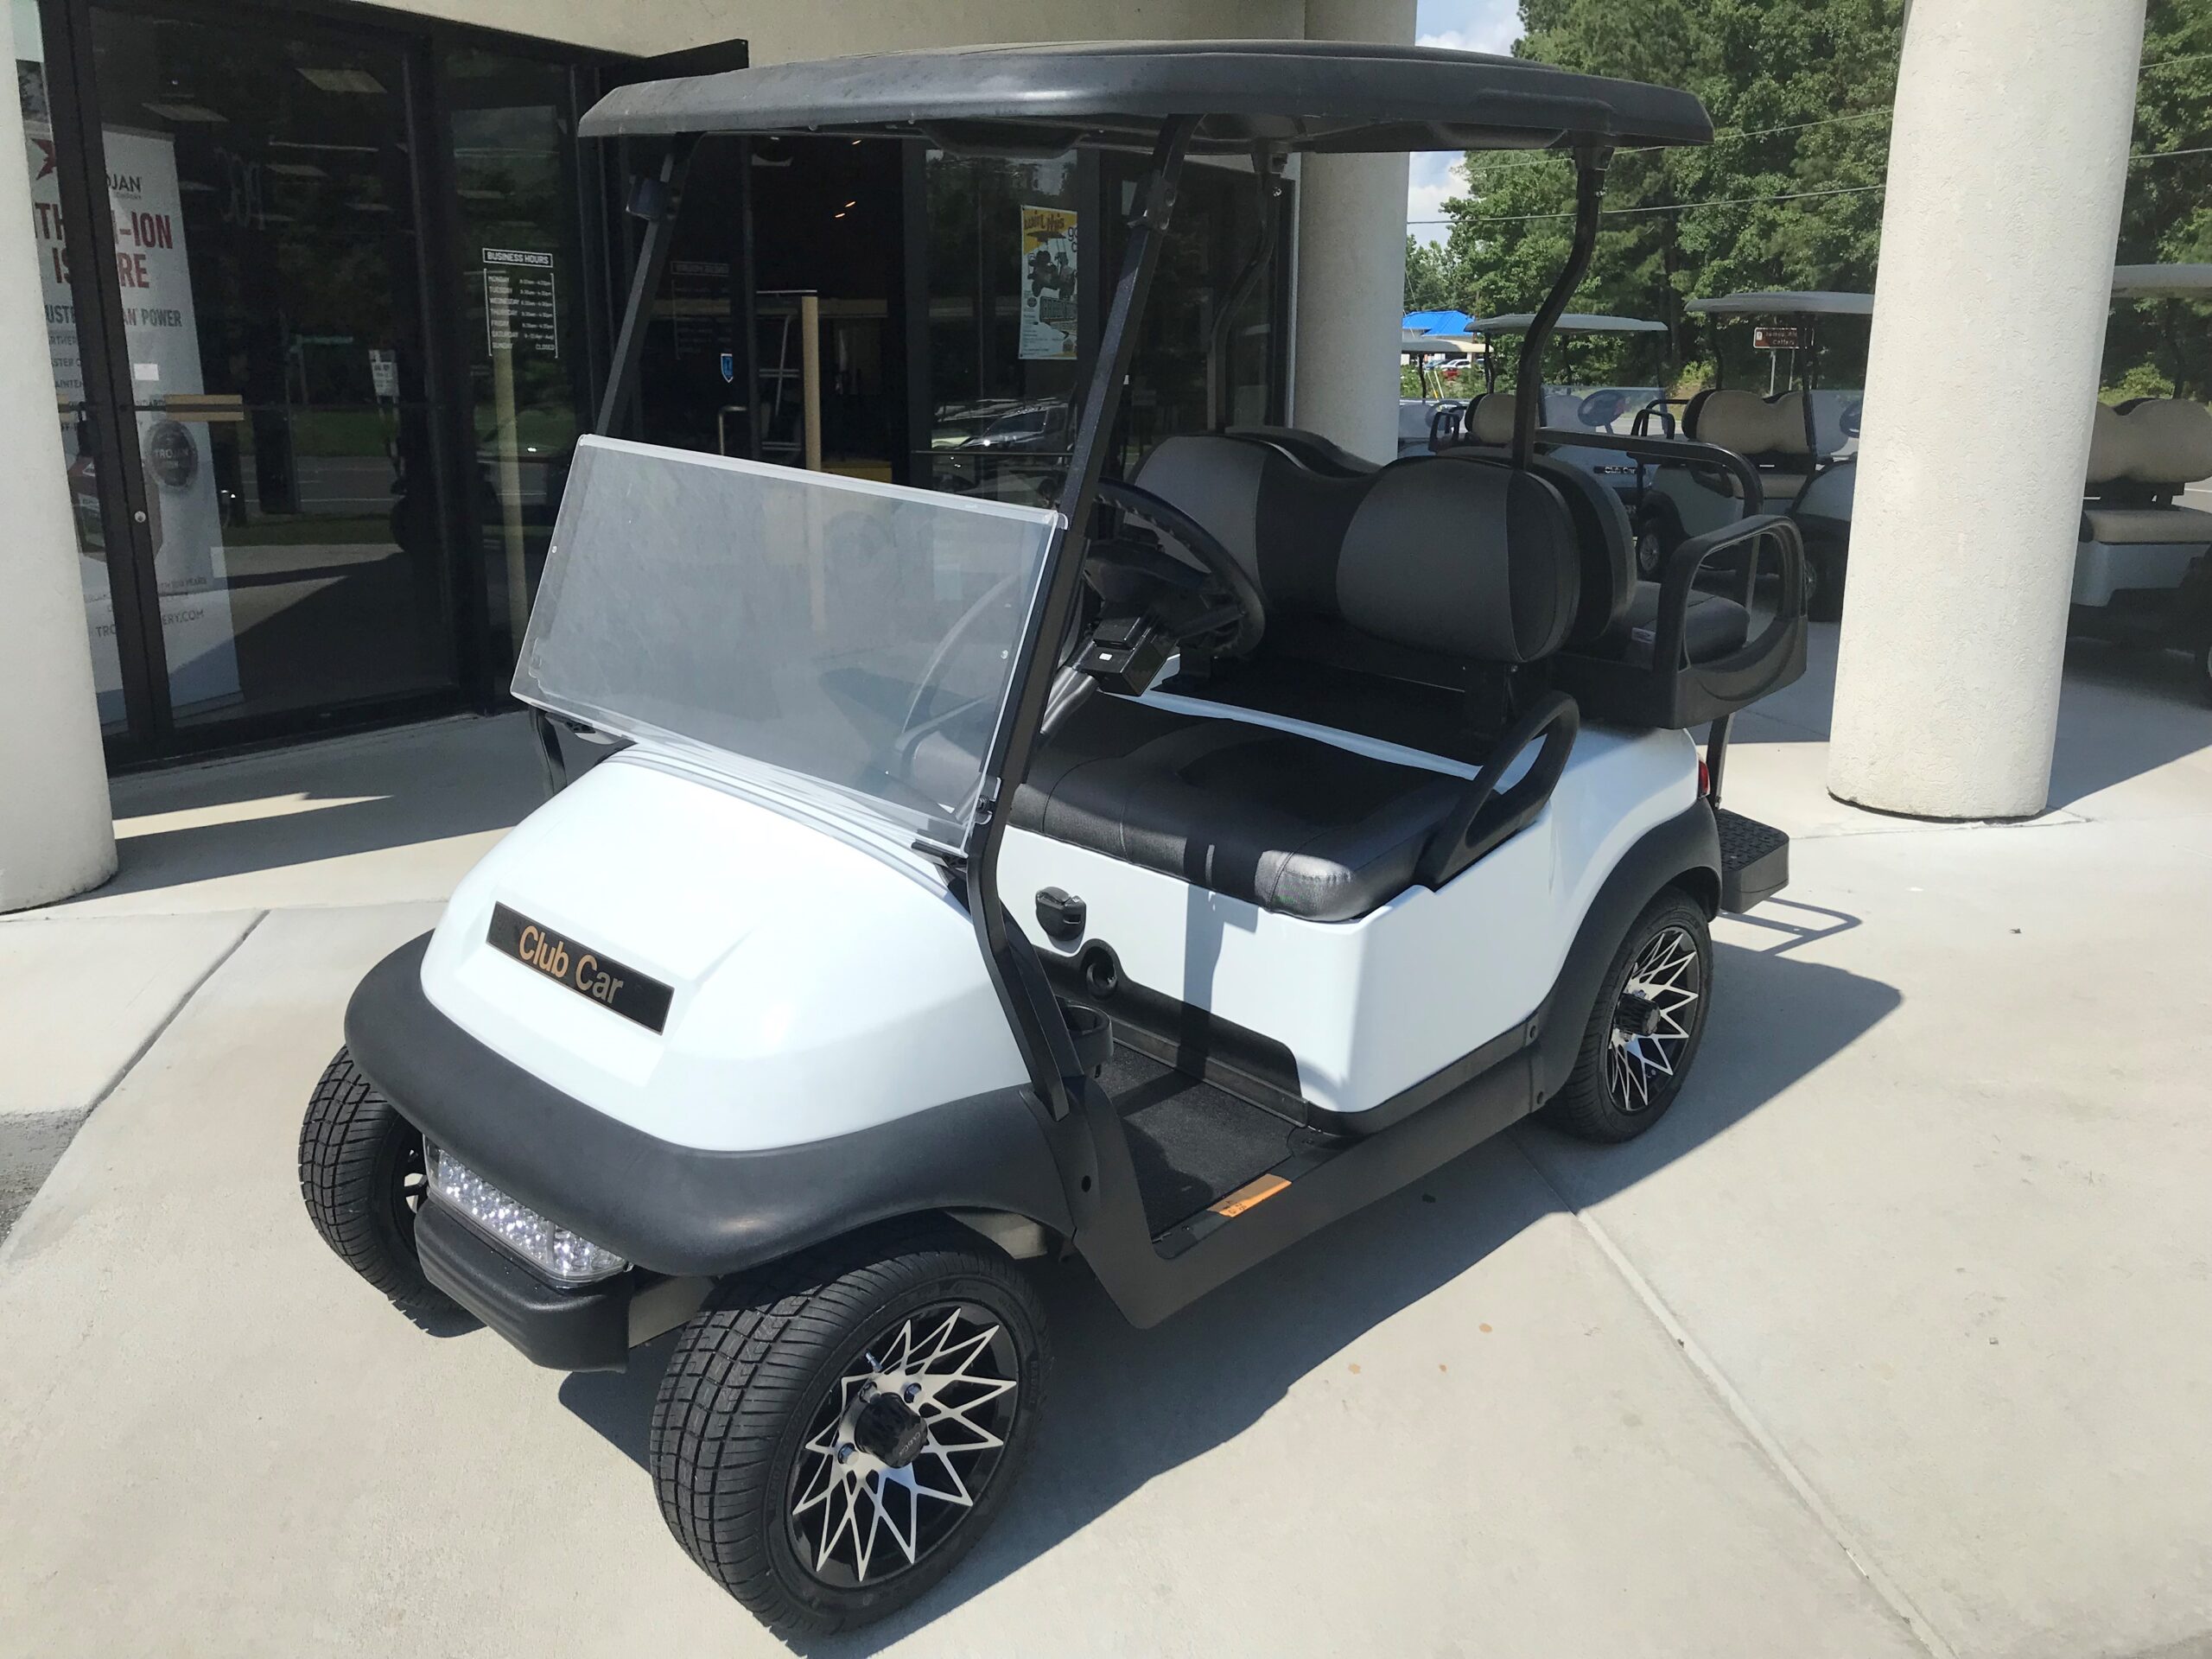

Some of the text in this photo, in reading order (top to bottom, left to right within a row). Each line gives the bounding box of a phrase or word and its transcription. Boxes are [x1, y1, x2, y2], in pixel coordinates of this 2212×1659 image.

[487, 251, 549, 264] BUSINESS HOURS
[142, 308, 182, 327] POWER
[519, 925, 624, 1004] Club Car
